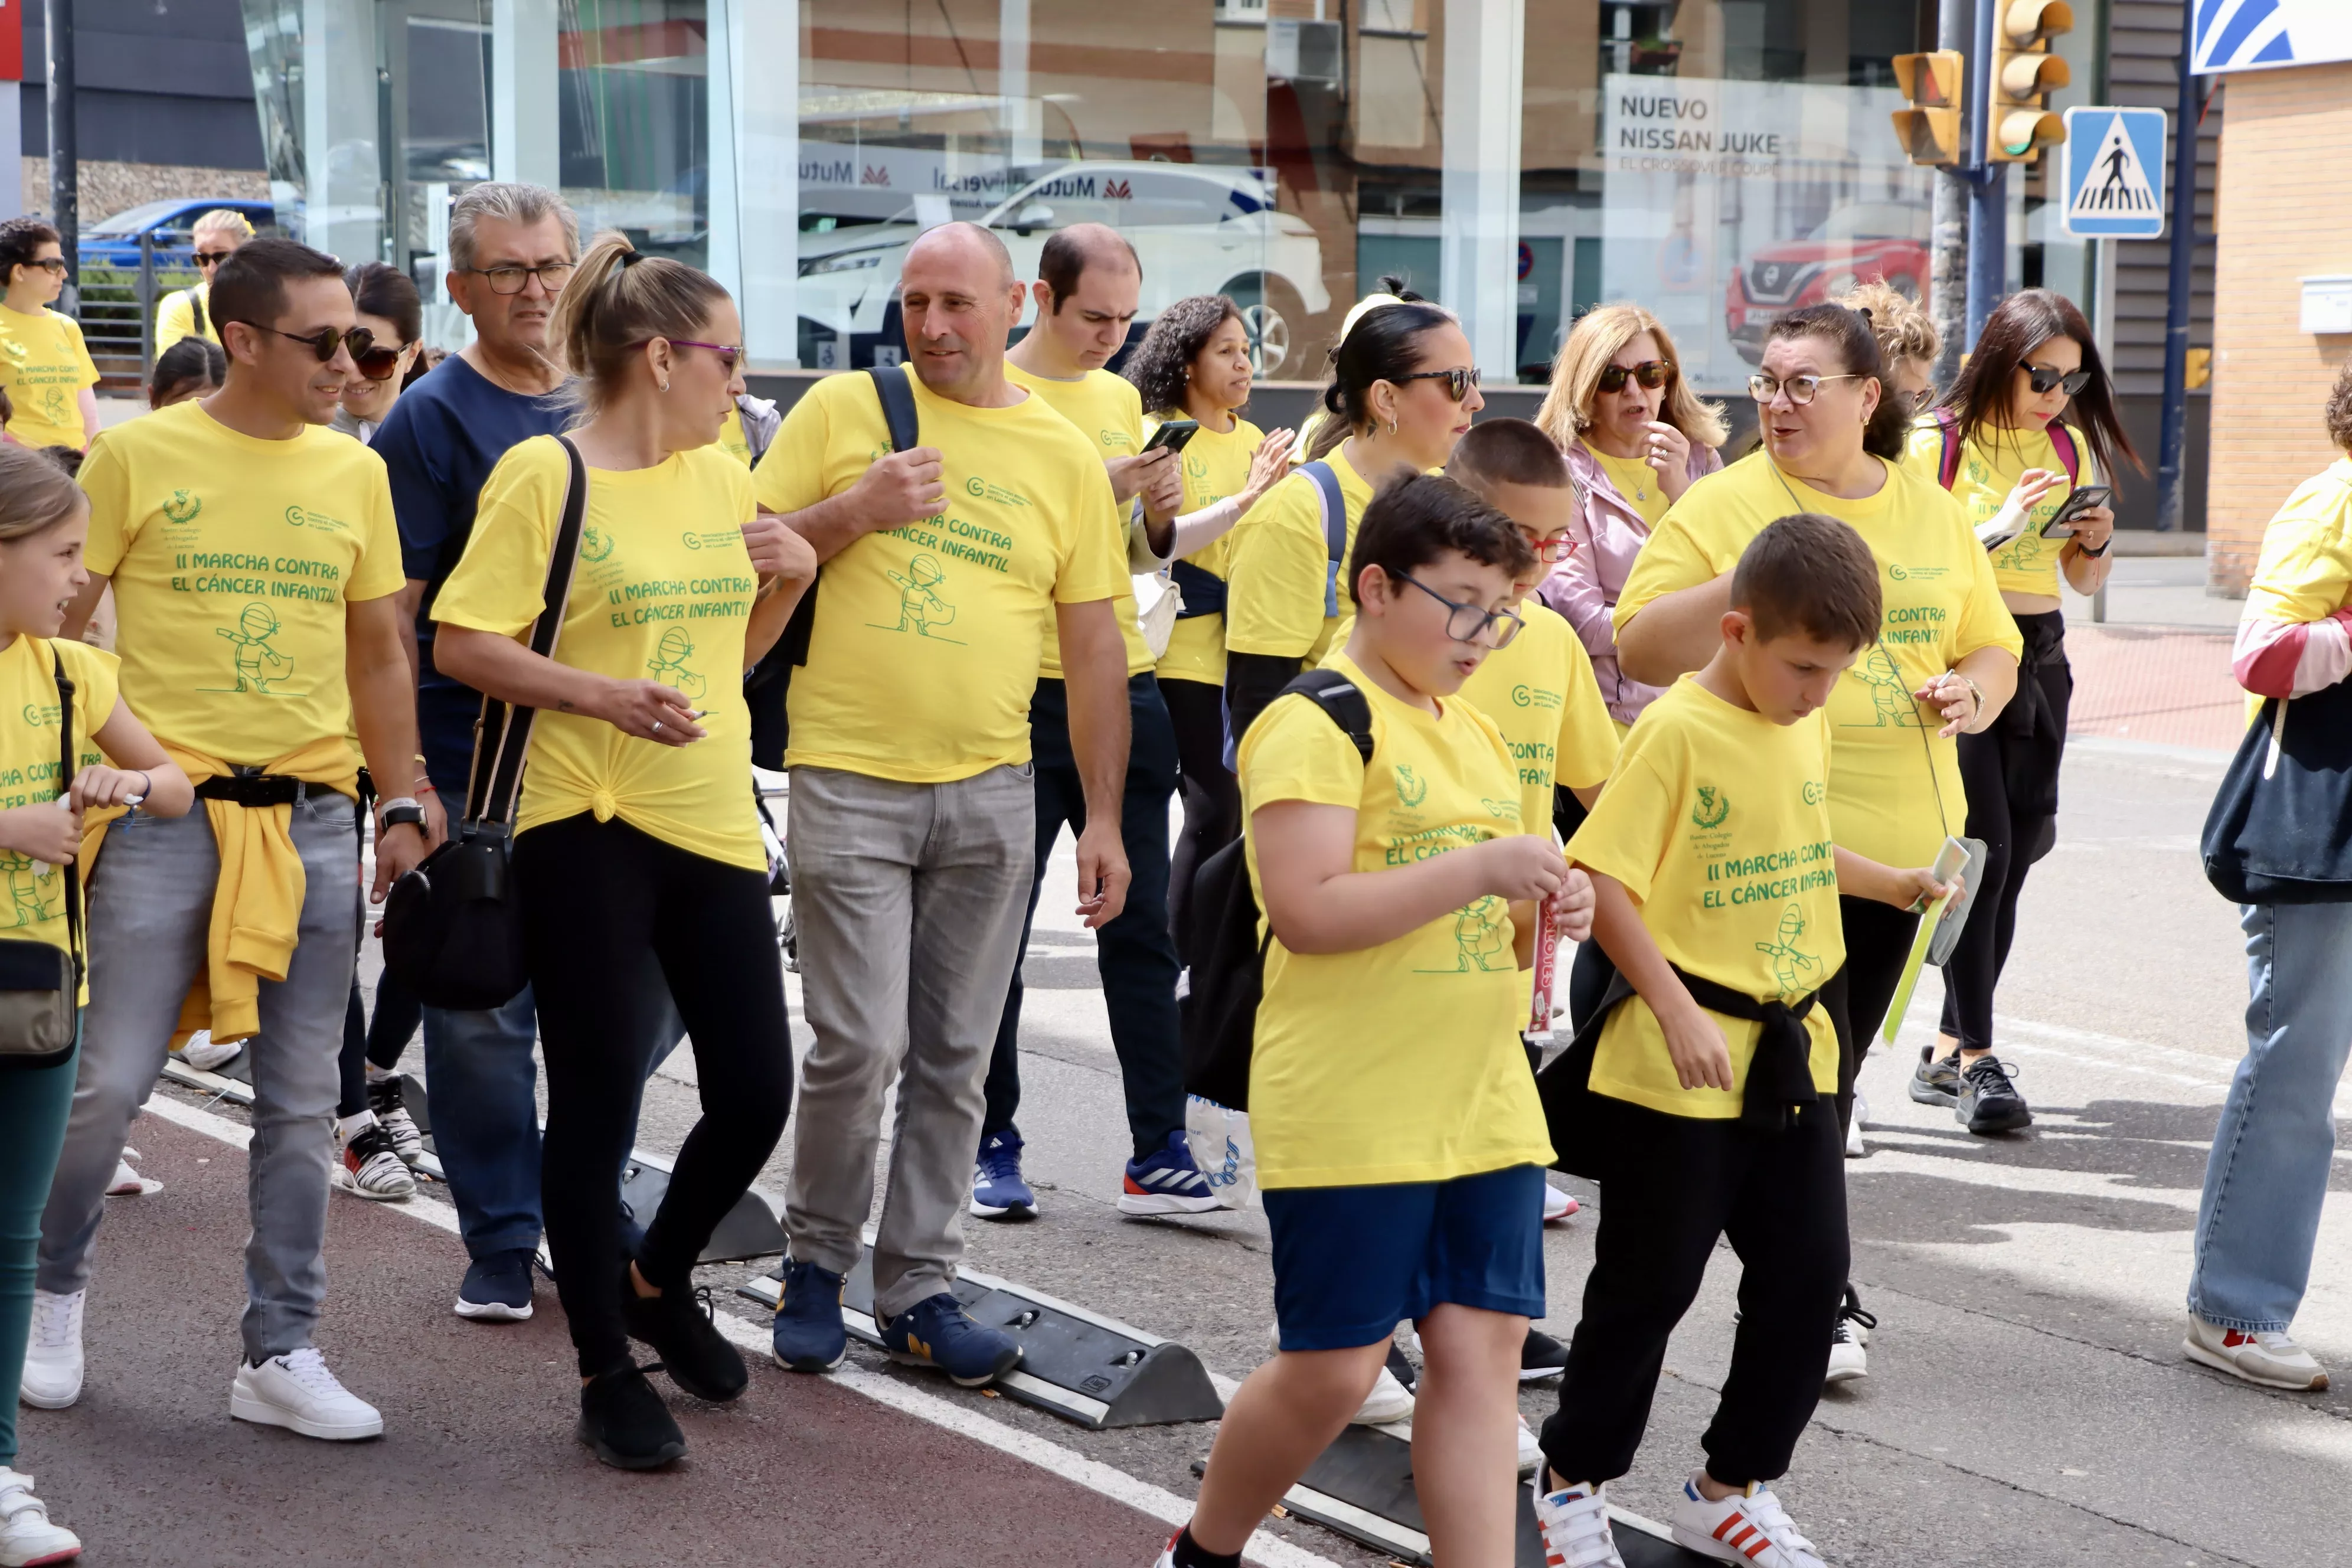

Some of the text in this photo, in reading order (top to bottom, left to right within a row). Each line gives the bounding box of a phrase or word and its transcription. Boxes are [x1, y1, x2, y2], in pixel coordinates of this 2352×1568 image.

[1620, 96, 1708, 120] NUEVO
[1620, 127, 1781, 154] NISSAN JUKE
[1979, 504, 1986, 514] II
[949, 518, 1012, 551] CONTRA
[176, 553, 339, 581] II MARCHA CONTRA
[941, 539, 1009, 573] INFANTIL
[172, 573, 337, 603] EL CÁNCER INFANTIL
[609, 577, 752, 605] II MARCHA CONTRA
[611, 600, 750, 628] EL CÁNCER INFANTIL
[1888, 607, 1946, 623] CONTRA
[1701, 842, 1730, 850] Abogados
[1710, 832, 1733, 840] Colegio
[1386, 848, 1410, 865] EL
[1707, 863, 1720, 881] II
[1725, 849, 1798, 879] MARCHA
[1703, 889, 1726, 908] EL
[1730, 880, 1798, 904] CÁNCER
